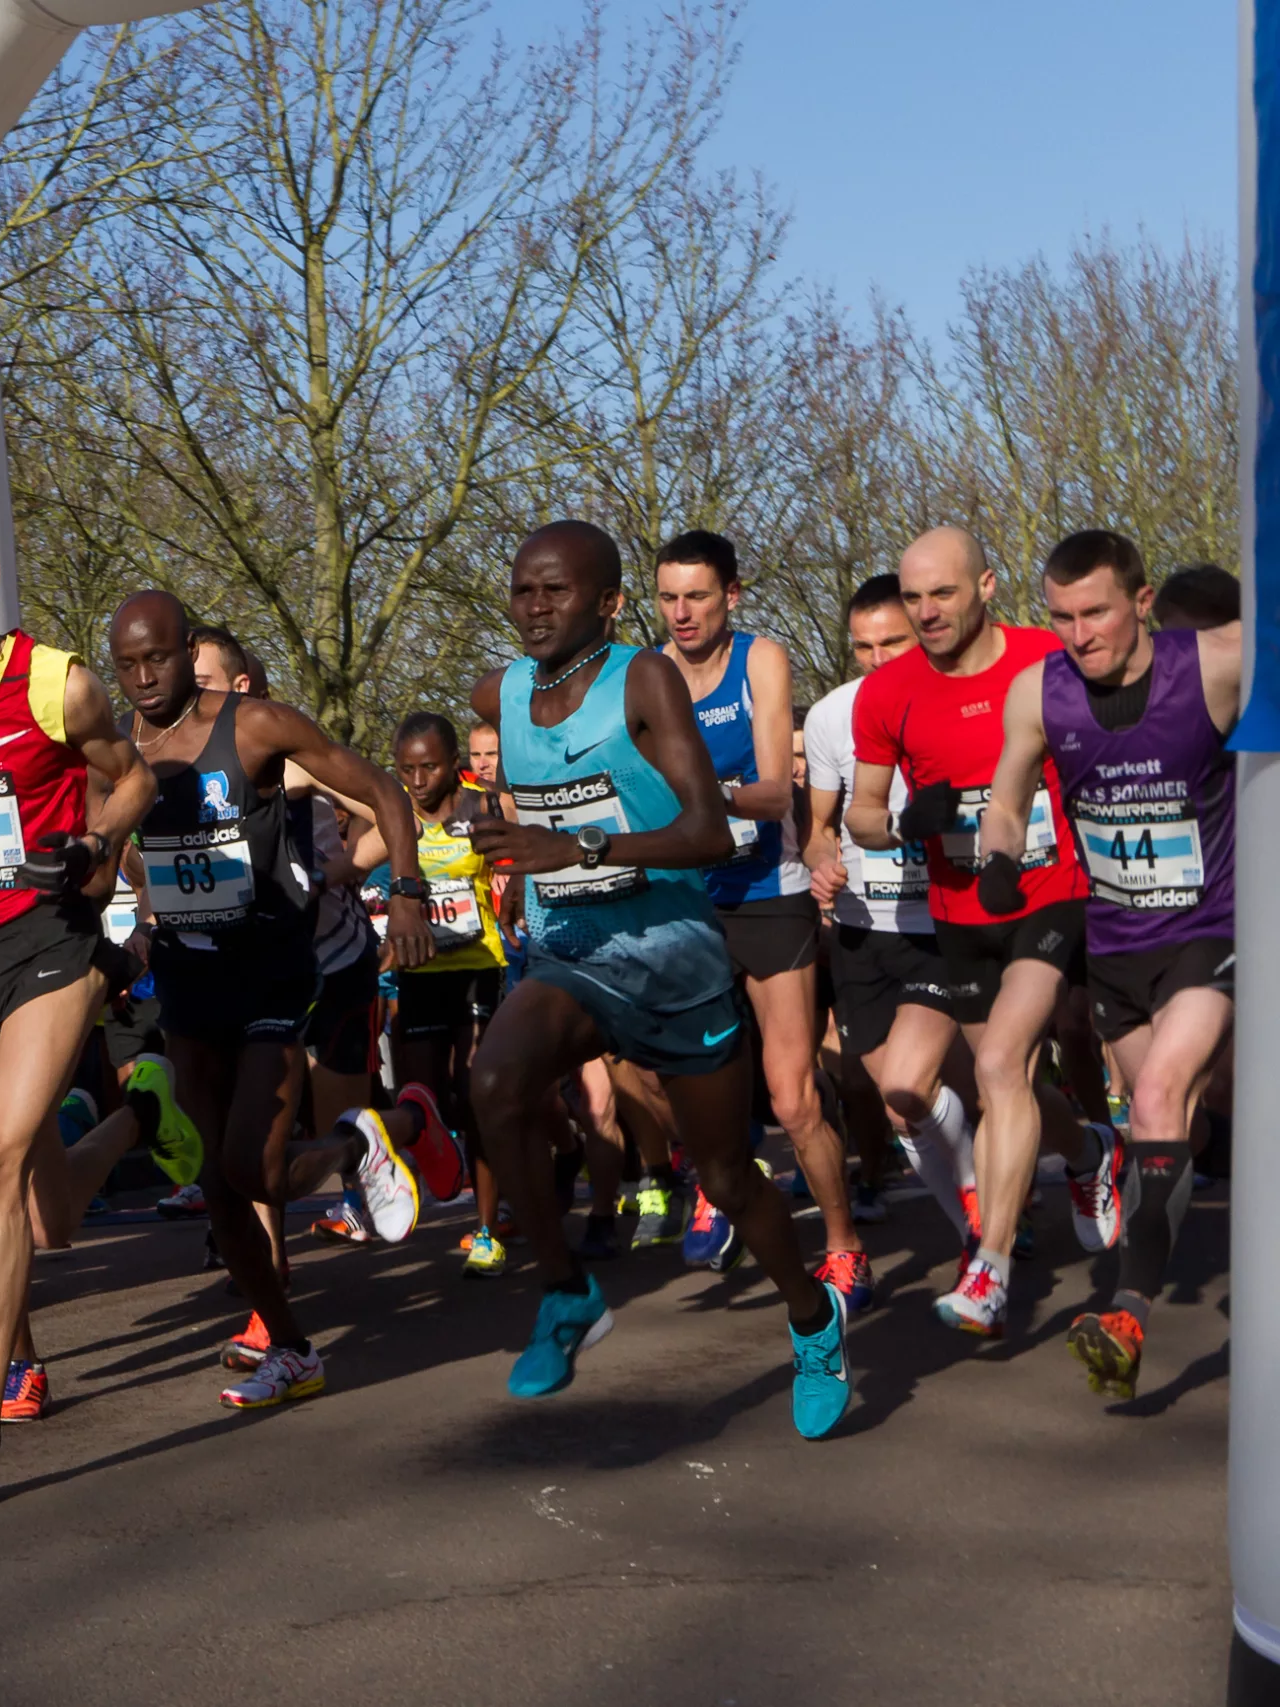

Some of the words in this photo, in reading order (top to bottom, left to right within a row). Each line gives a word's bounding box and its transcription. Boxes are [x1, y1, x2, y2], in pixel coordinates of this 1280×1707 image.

[698, 702, 740, 721] DASSAULT
[704, 712, 737, 727] SPORTS
[1095, 759, 1161, 779] Tarkett
[544, 781, 609, 806] adidas
[1111, 781, 1188, 802] SOMMER
[1077, 801, 1181, 817] POWERADE
[183, 827, 240, 846] adidas
[1110, 828, 1158, 870] 44
[174, 852, 216, 895] 63
[1118, 874, 1156, 886] DAMIEN
[539, 873, 633, 898] POWERADE
[1133, 889, 1198, 908] adidas
[159, 910, 247, 925] POWERADE
